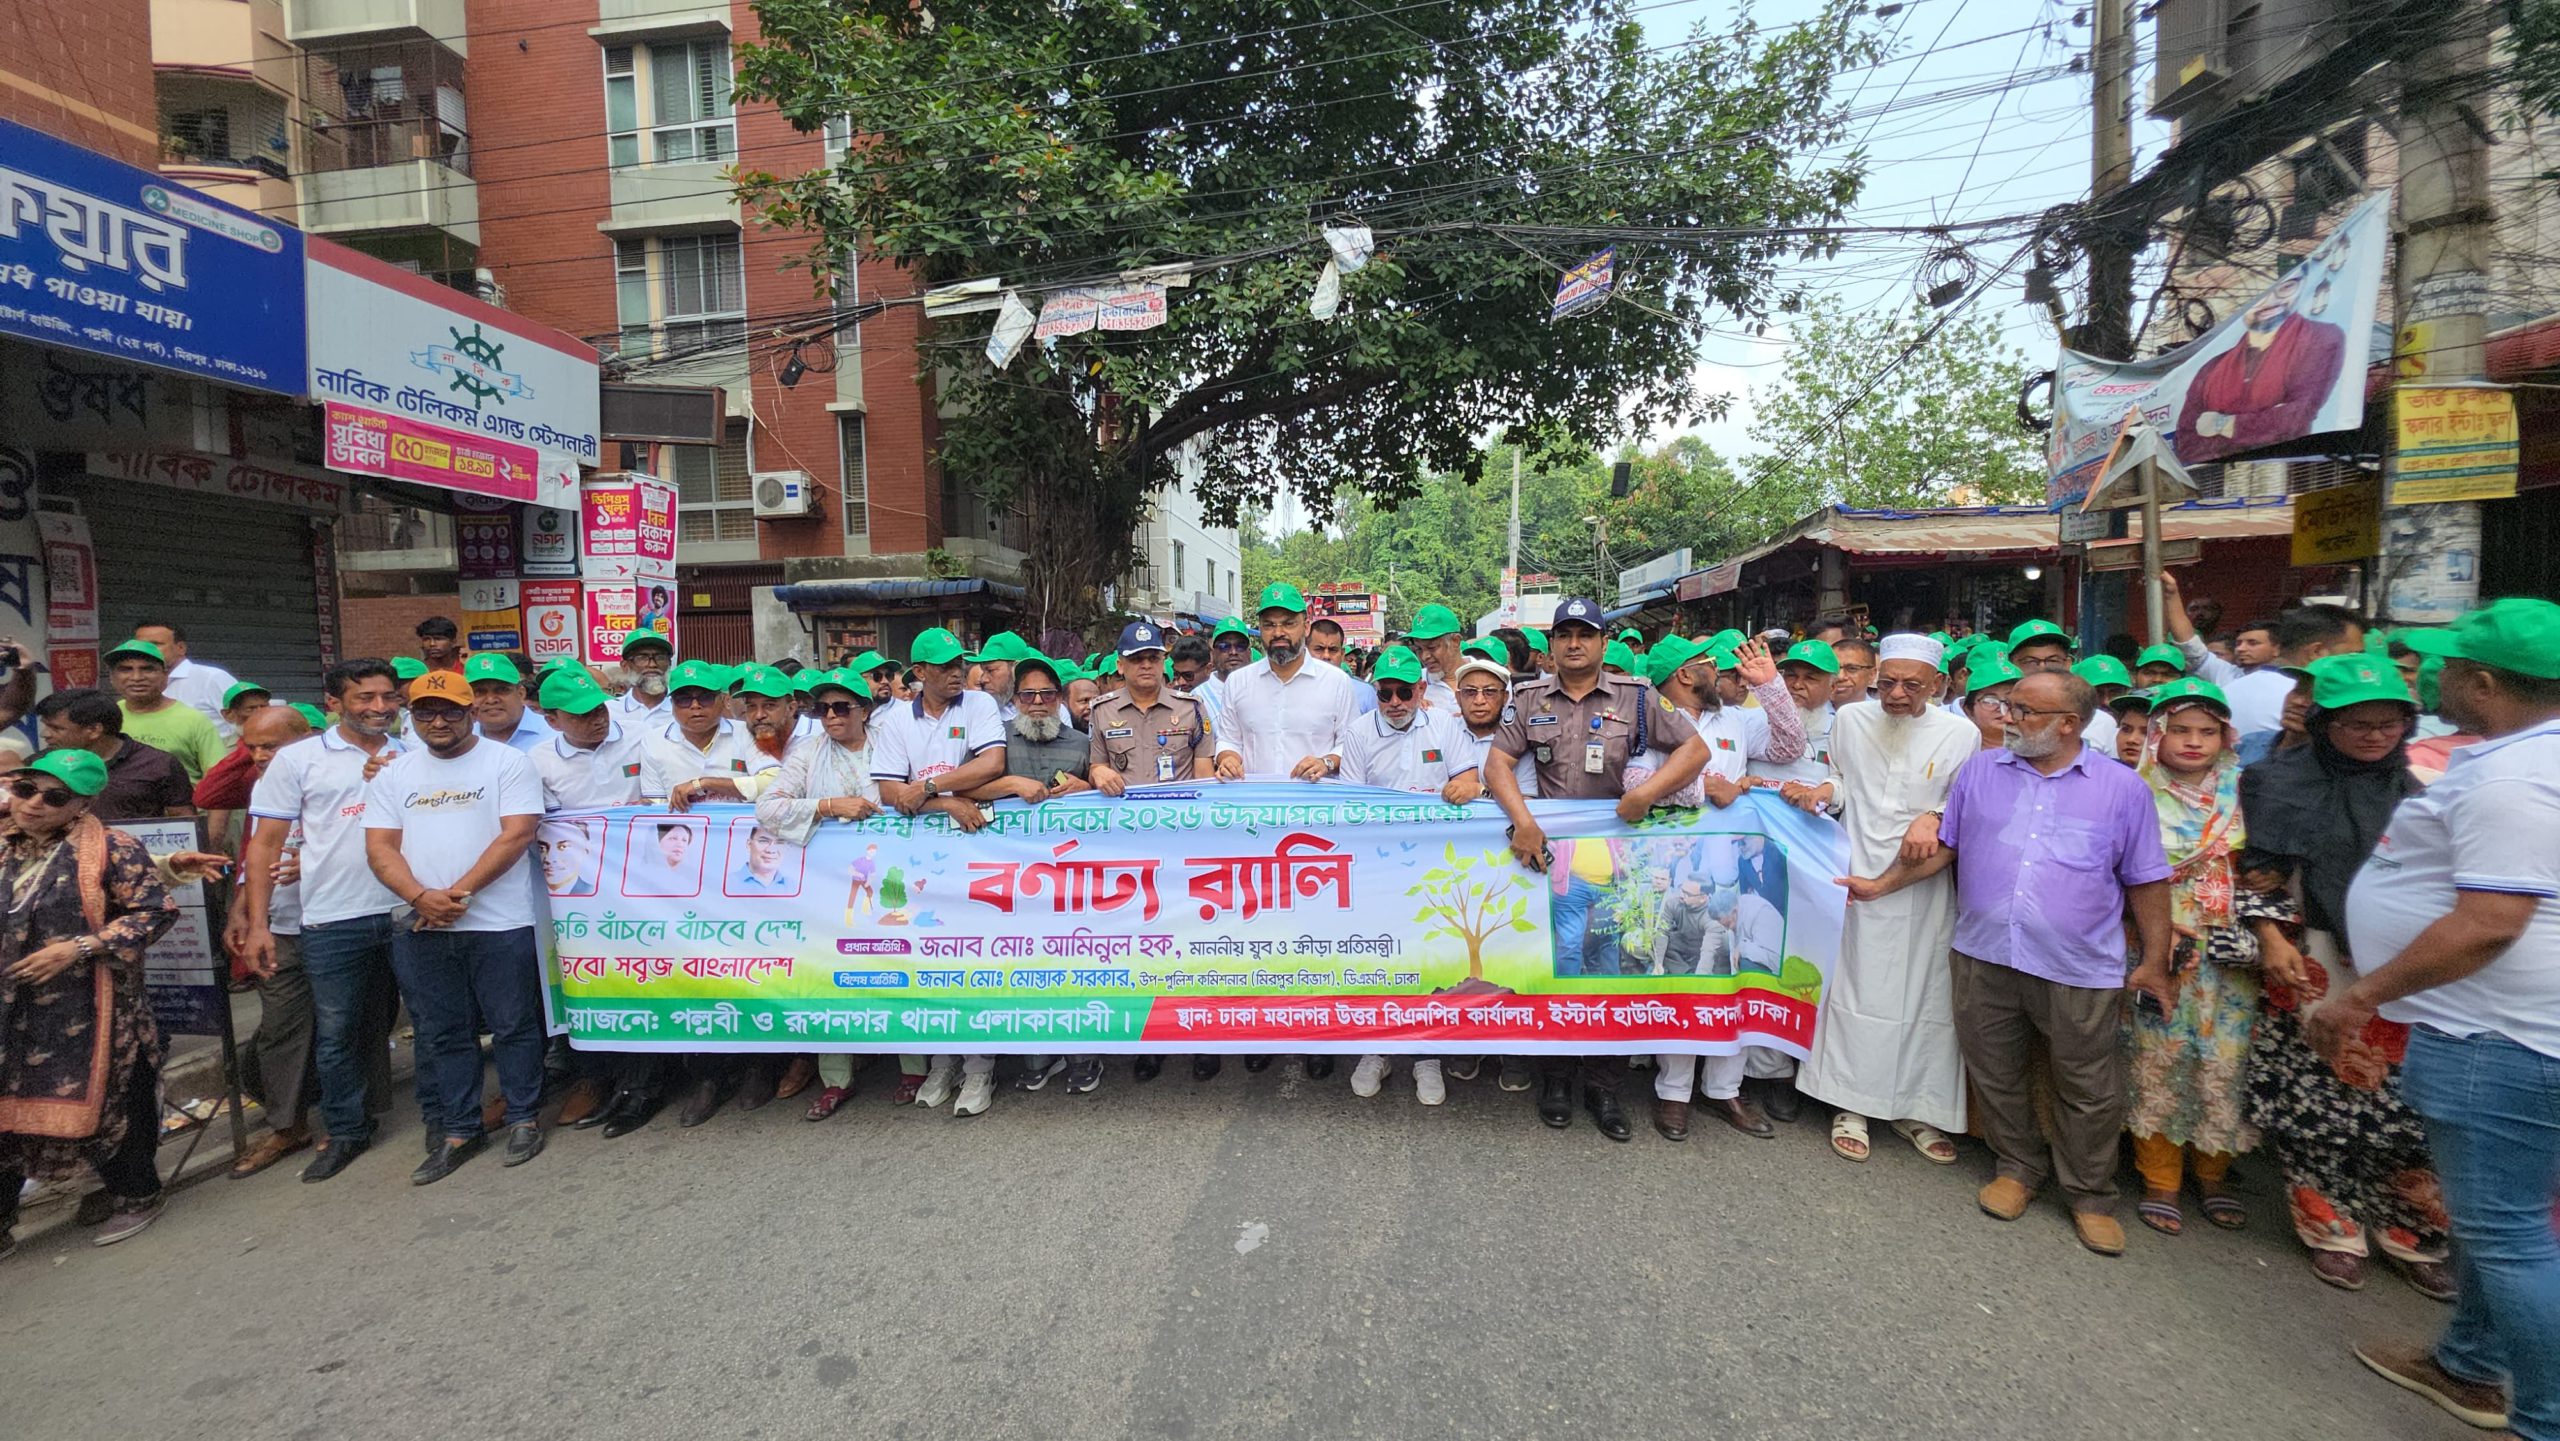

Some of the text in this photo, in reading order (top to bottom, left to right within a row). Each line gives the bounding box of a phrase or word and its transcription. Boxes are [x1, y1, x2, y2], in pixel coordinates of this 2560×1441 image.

[171, 206, 260, 243] MEDICINE SHOP
[44, 277, 129, 314] পাওয়া
[316, 366, 390, 404] নাবিক
[396, 386, 479, 428] টেলিকম
[528, 423, 598, 458] স্টেশনারী
[331, 421, 387, 449] সুবিধা
[331, 443, 386, 469] ডাবল
[459, 458, 493, 475] ১৪.৯০
[500, 457, 512, 481] ২
[591, 492, 630, 505] ডিপিএস
[648, 509, 667, 528] বিল
[532, 533, 565, 547] নগদ
[639, 519, 672, 543] বিকাশ
[643, 540, 668, 555] করুন
[592, 625, 626, 643] বিক
[605, 614, 637, 630] বিল
[534, 637, 573, 653] নগদ
[404, 786, 485, 808] Constraint
[1038, 801, 1113, 834] দিবস
[1117, 803, 1203, 832] ২০২৬
[967, 839, 1161, 922] বর্ণাঢ্য
[597, 910, 668, 947] বাঁচলে
[676, 911, 747, 947] বাঁচবে
[844, 942, 870, 952] প্রধান
[919, 936, 984, 958] জনাব
[1042, 927, 1132, 963] আমিনুল
[1189, 934, 1245, 957] মাননীয়
[1249, 939, 1272, 960] যুব
[1276, 941, 1287, 955] ও
[1293, 934, 1333, 956] ক্রীড়া
[614, 956, 676, 984] সবুজ
[682, 955, 795, 984] বাংলাদেশ
[917, 970, 966, 990] জনাব
[1009, 969, 1066, 990] মোস্তাক
[1072, 969, 1135, 990] সরকার,
[1139, 970, 1194, 990] উপ-পুলিশ
[1198, 970, 1248, 986] কমিশনার
[1251, 970, 1294, 990] (মিরপুর
[1394, 971, 1420, 986] ঢাকা
[670, 1001, 743, 1036] পল্লবী
[752, 1011, 773, 1032] ও
[783, 1007, 892, 1035] রূপনগর
[900, 1007, 960, 1035] থানা
[969, 1001, 1114, 1036] এলাকাবাসী
[1217, 1007, 1258, 1028] ঢাকা
[1262, 1006, 1330, 1028] মহানগর
[1335, 1002, 1377, 1028] উত্তর
[1383, 1001, 1460, 1027] বিএনপির
[1548, 1000, 1606, 1028] ইস্টার্ন
[1747, 999, 1791, 1027] ঢাকা
